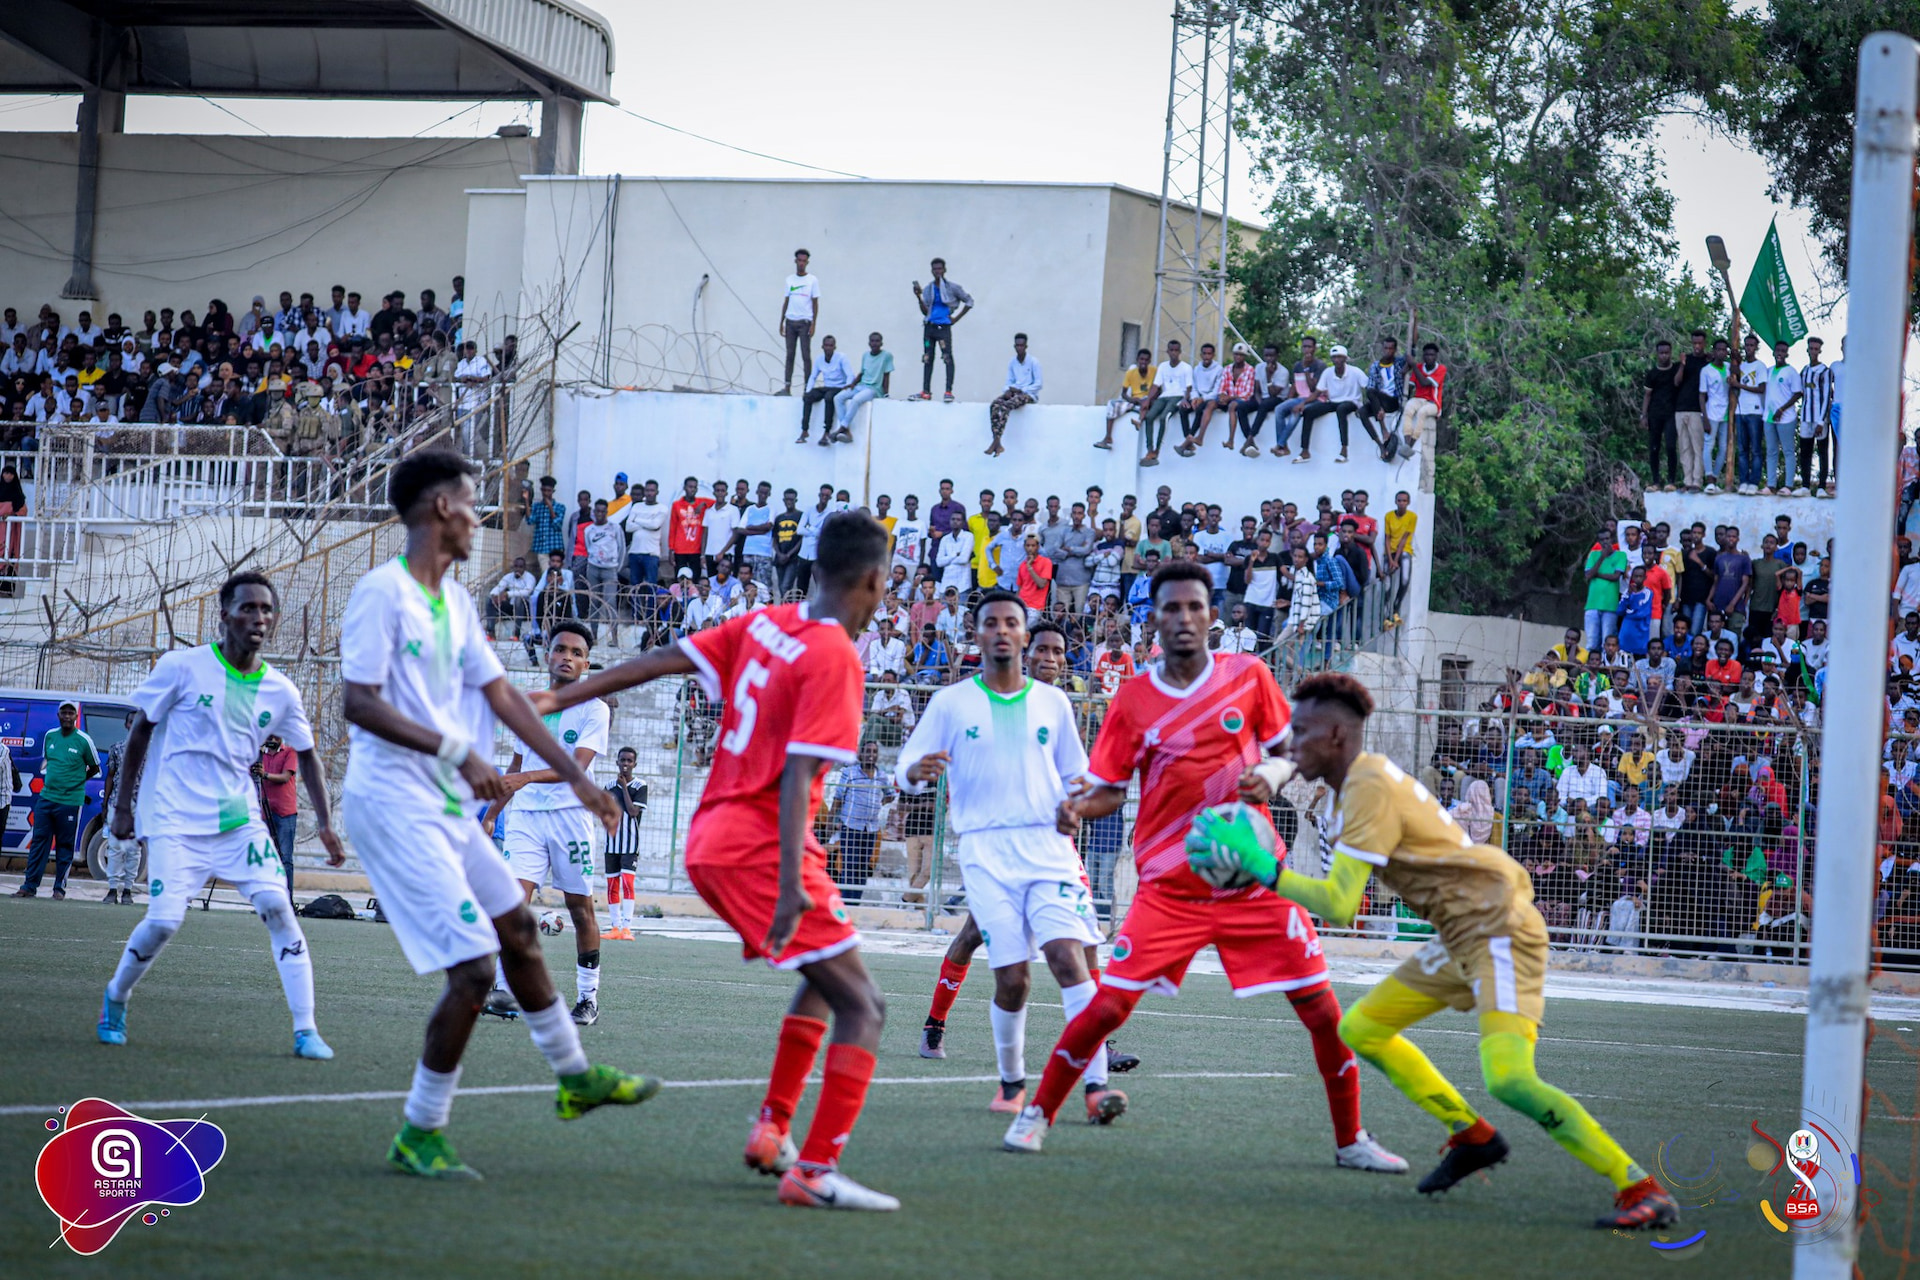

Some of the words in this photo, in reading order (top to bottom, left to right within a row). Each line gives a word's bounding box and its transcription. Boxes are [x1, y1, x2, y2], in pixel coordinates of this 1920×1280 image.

[1781, 293, 1804, 339] NABADA
[1101, 669, 1121, 699] 9
[721, 658, 771, 756] 5
[247, 838, 278, 868] 44
[568, 840, 592, 865] 22
[1287, 906, 1308, 943] 4
